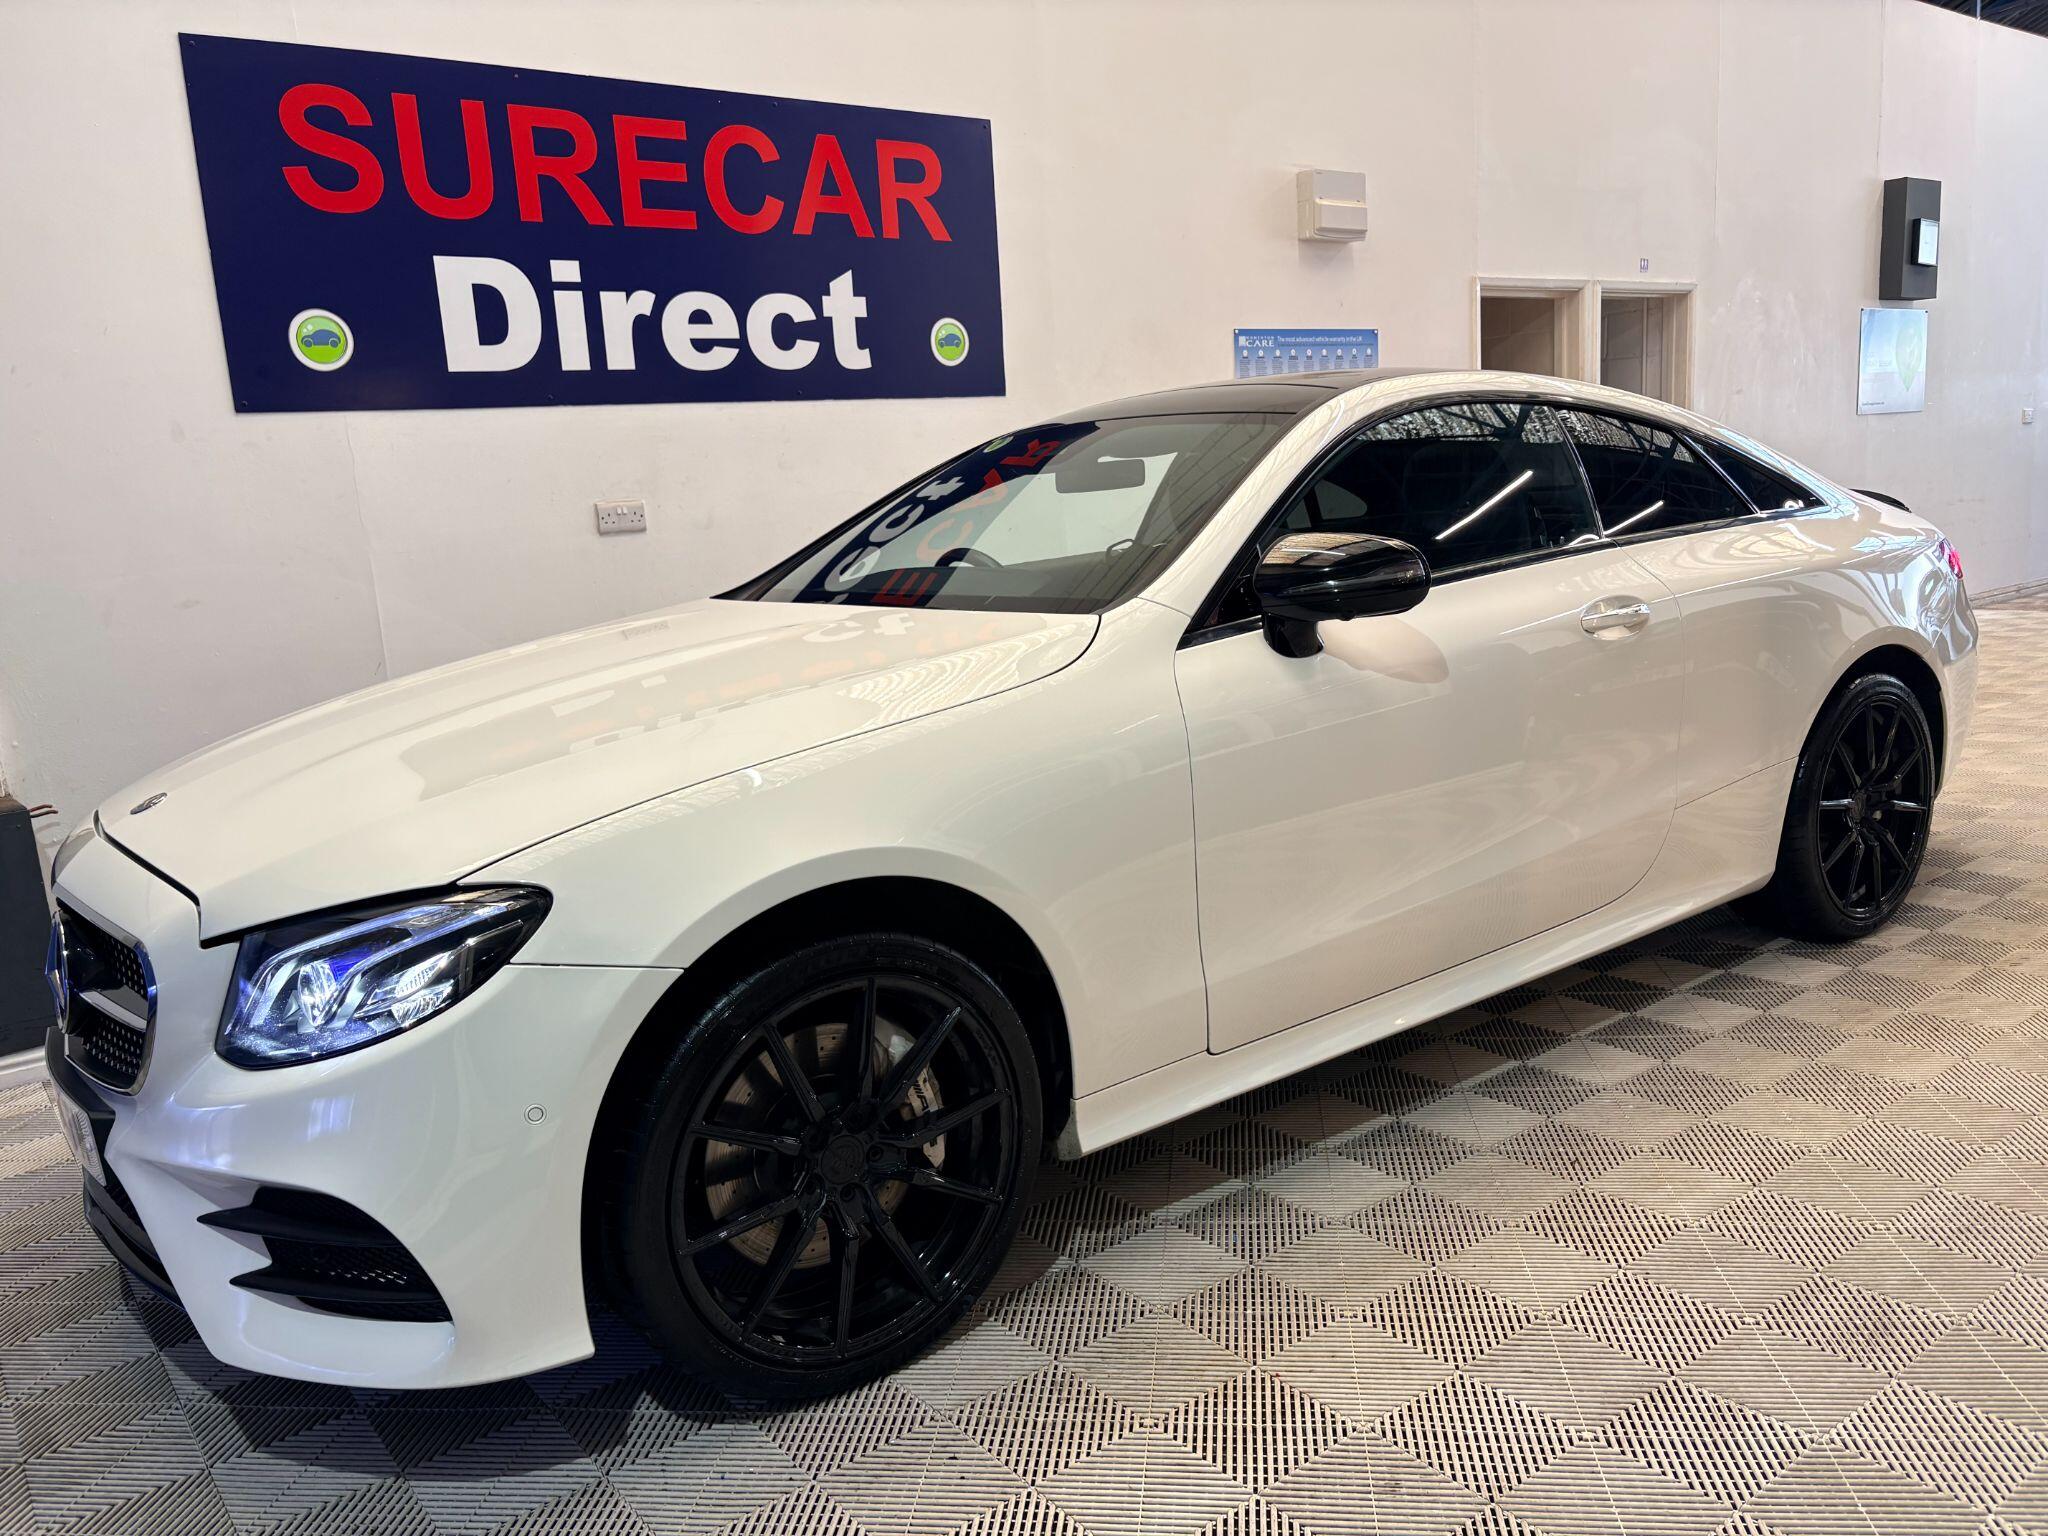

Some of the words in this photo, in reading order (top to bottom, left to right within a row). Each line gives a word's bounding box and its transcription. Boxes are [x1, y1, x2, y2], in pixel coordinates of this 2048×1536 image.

[279, 84, 951, 241] SURECAR
[433, 256, 871, 372] Direct
[1246, 339, 1275, 348] CARE
